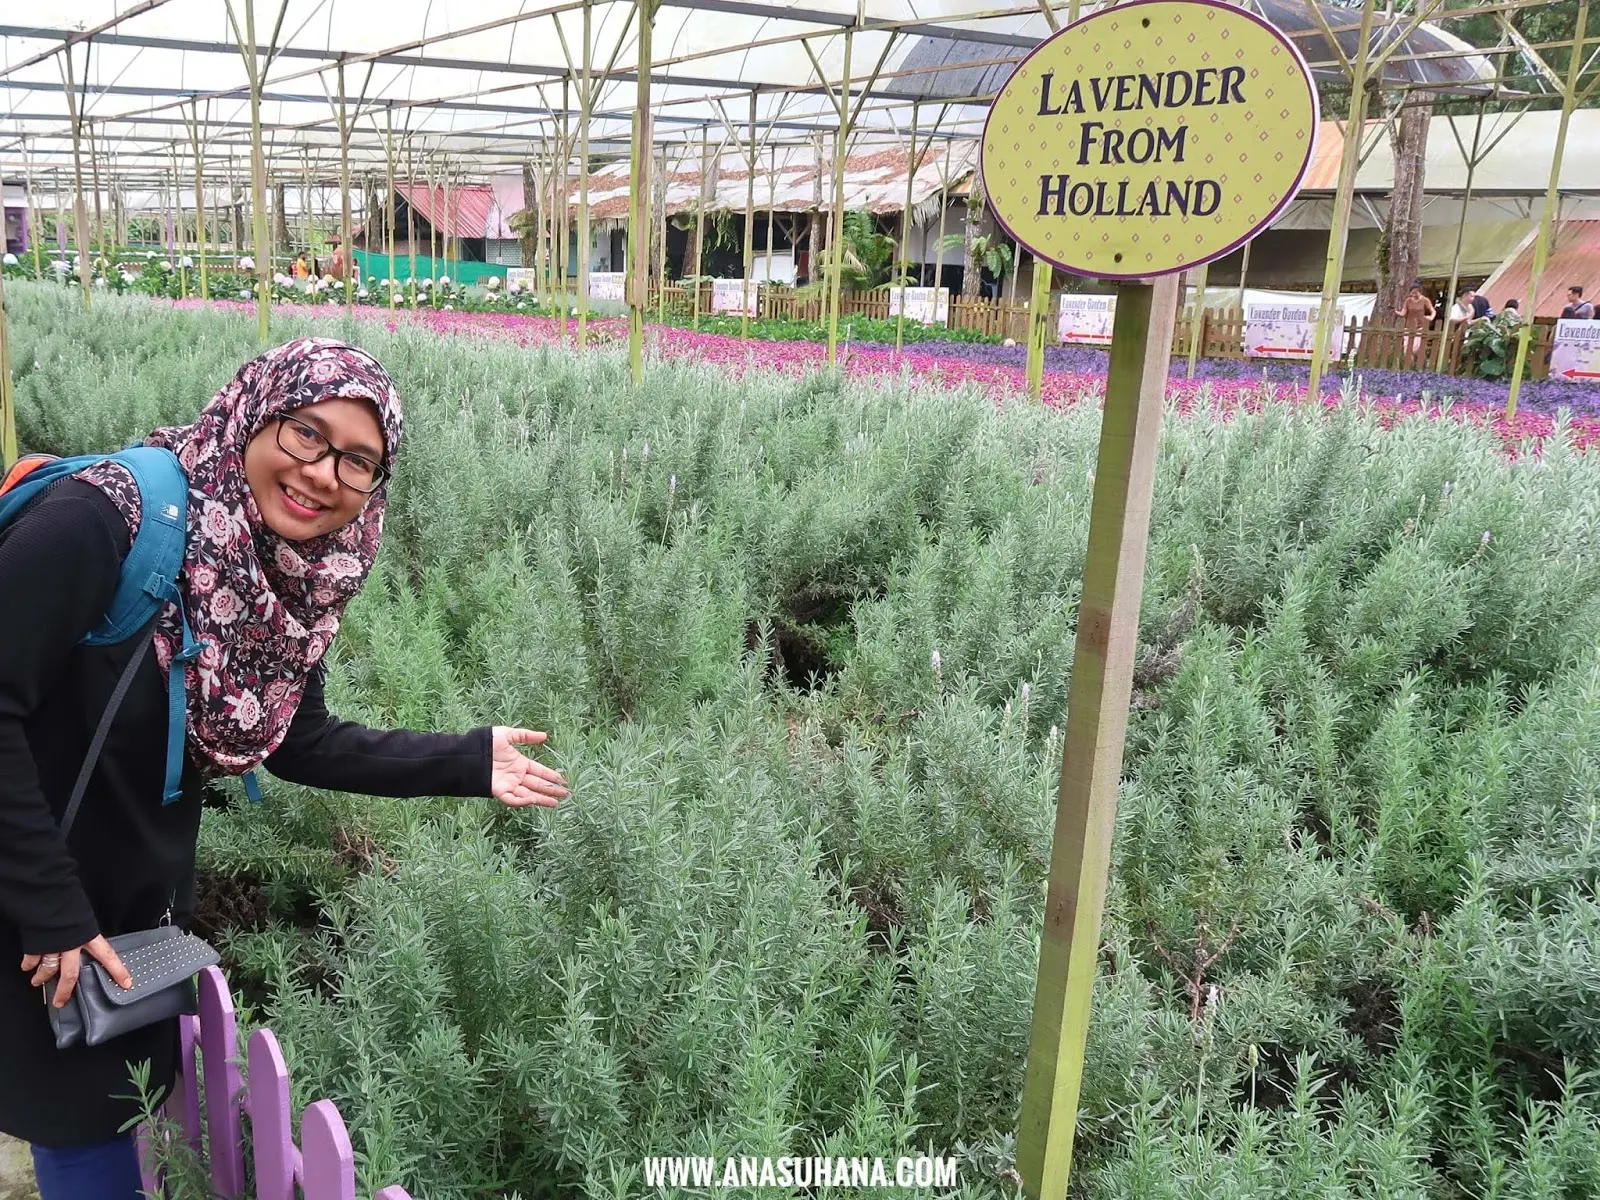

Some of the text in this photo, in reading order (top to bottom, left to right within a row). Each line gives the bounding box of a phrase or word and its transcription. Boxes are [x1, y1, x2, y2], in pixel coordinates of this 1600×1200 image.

[1037, 66, 1247, 116] LAVENDER
[1076, 122, 1188, 165] FROM
[1036, 174, 1221, 217] HOLLAND
[1282, 307, 1307, 321] Garden
